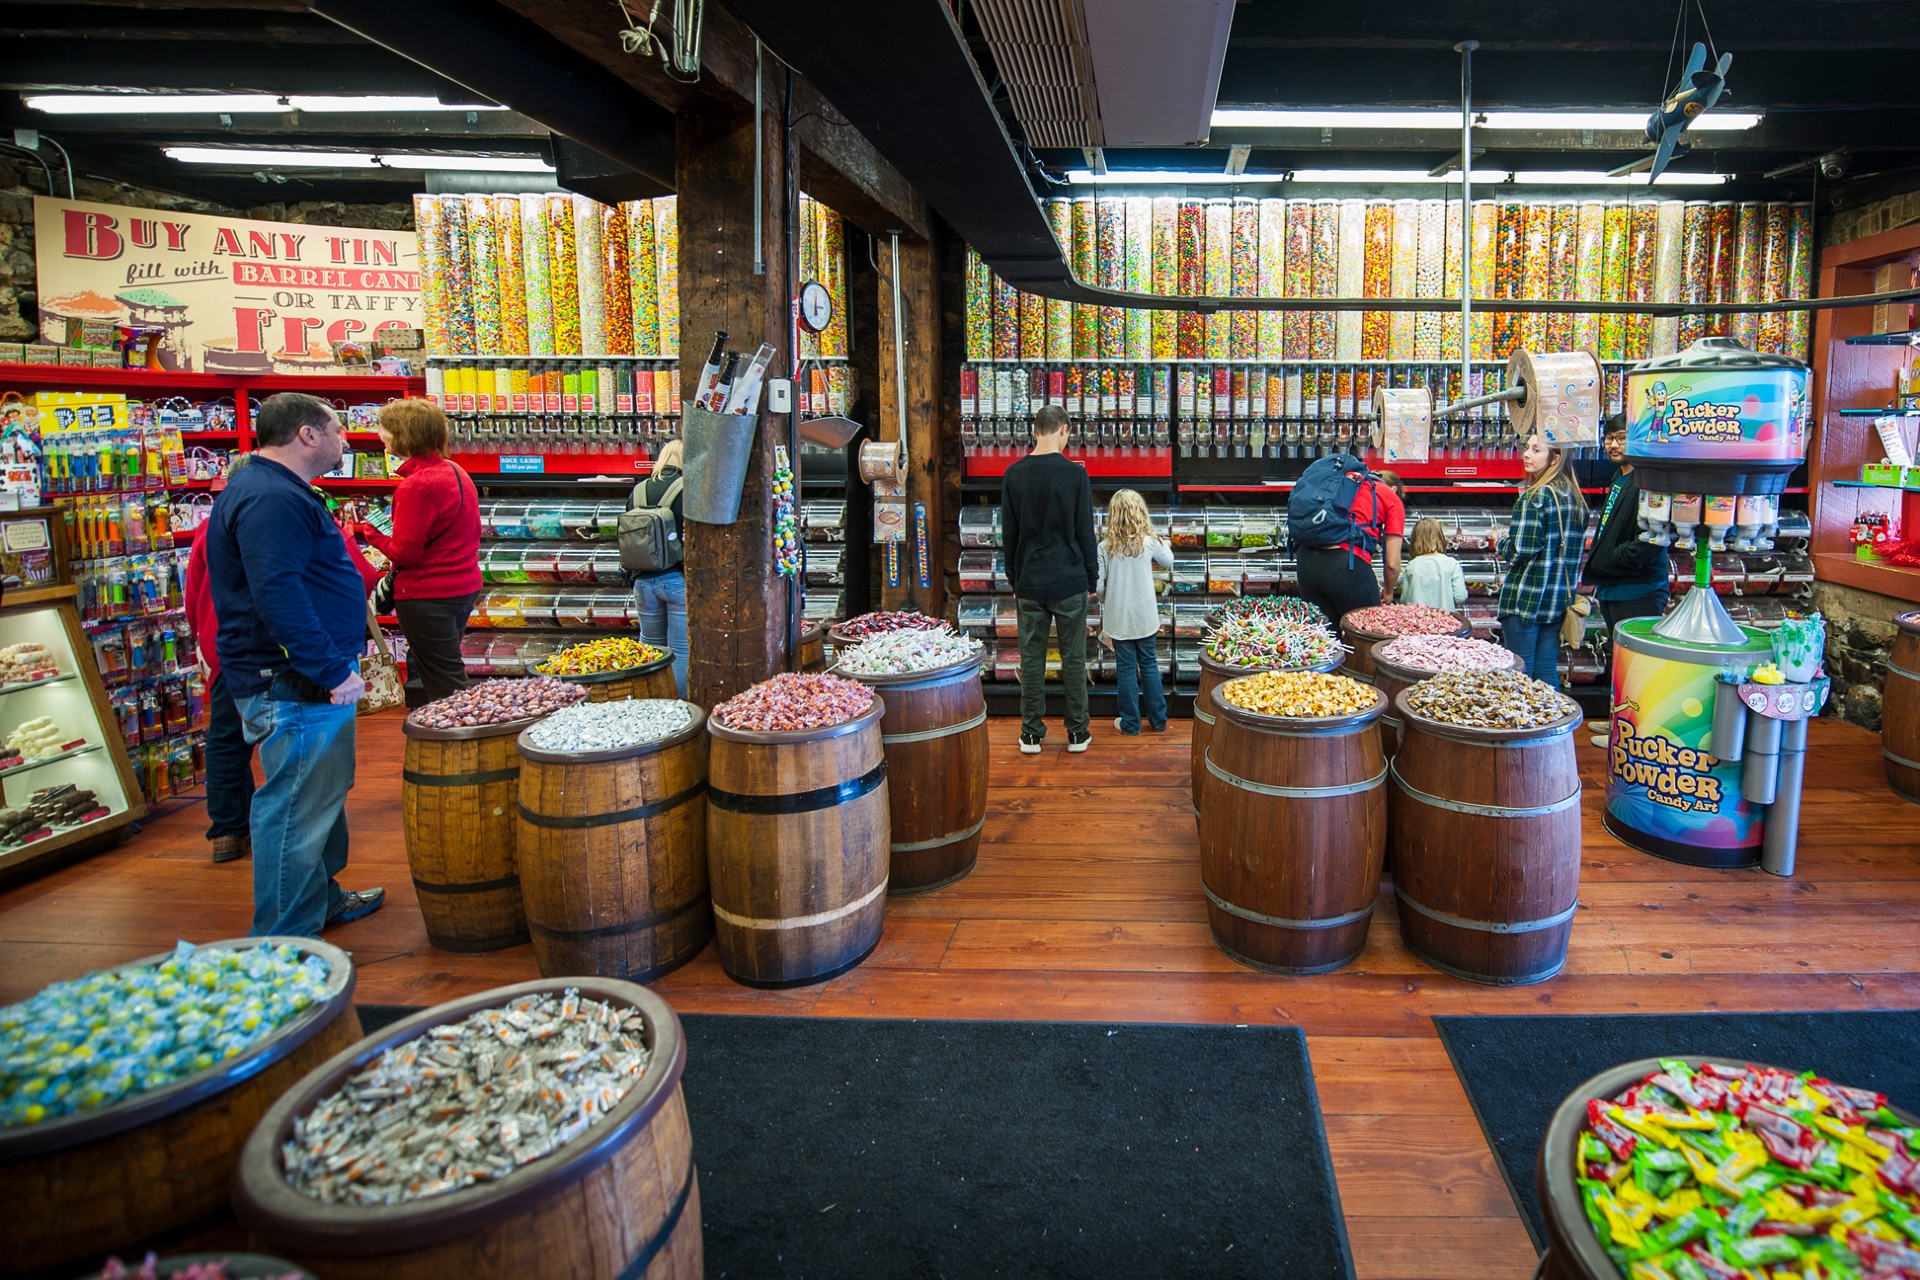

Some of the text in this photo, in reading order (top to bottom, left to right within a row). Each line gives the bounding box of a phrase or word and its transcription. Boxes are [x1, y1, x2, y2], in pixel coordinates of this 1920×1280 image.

[1684, 102, 1702, 115] 55
[213, 227, 305, 262] ANY
[325, 236, 398, 266] TIN
[126, 263, 165, 284] fill
[175, 260, 224, 277] with
[240, 265, 352, 287] BARREL
[273, 292, 419, 311] OR TAFFY
[54, 405, 116, 430] PEZ
[1671, 400, 1741, 419] Pucker
[1698, 434, 1740, 442] Candy Art
[1617, 719, 1719, 773] Pucker
[1647, 789, 1719, 813] Candy Art
